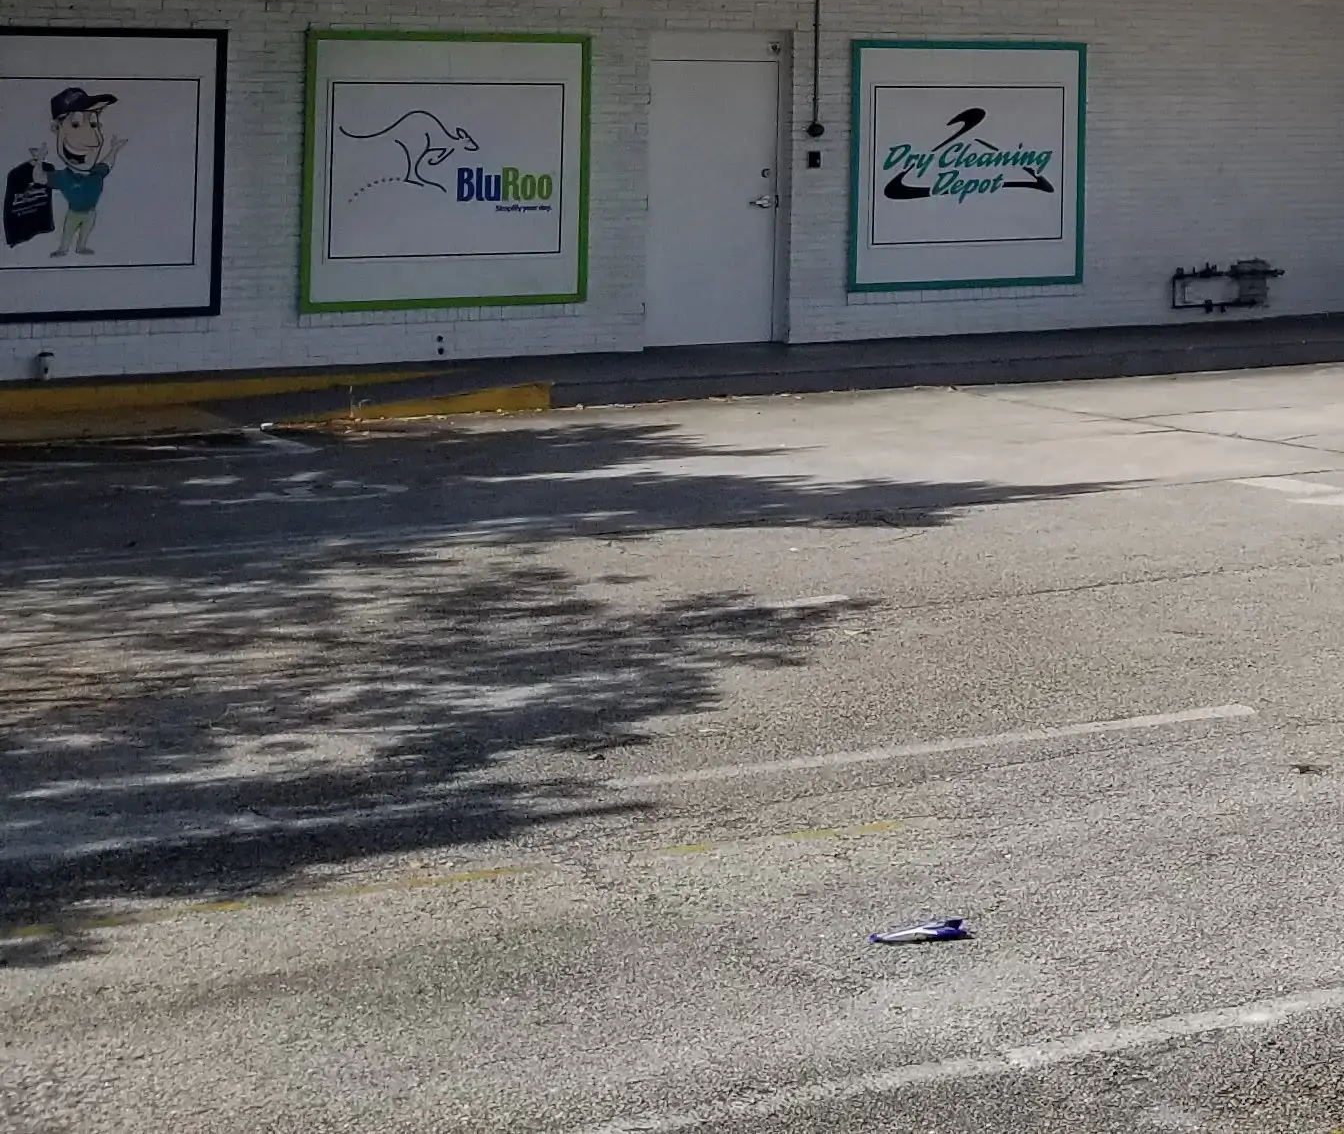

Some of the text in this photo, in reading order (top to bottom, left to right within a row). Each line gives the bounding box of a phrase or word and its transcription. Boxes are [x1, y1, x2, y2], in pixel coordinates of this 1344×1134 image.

[882, 141, 1053, 178] Dry Cleaning
[456, 166, 553, 202] BluRoo
[931, 169, 1004, 204] Depot
